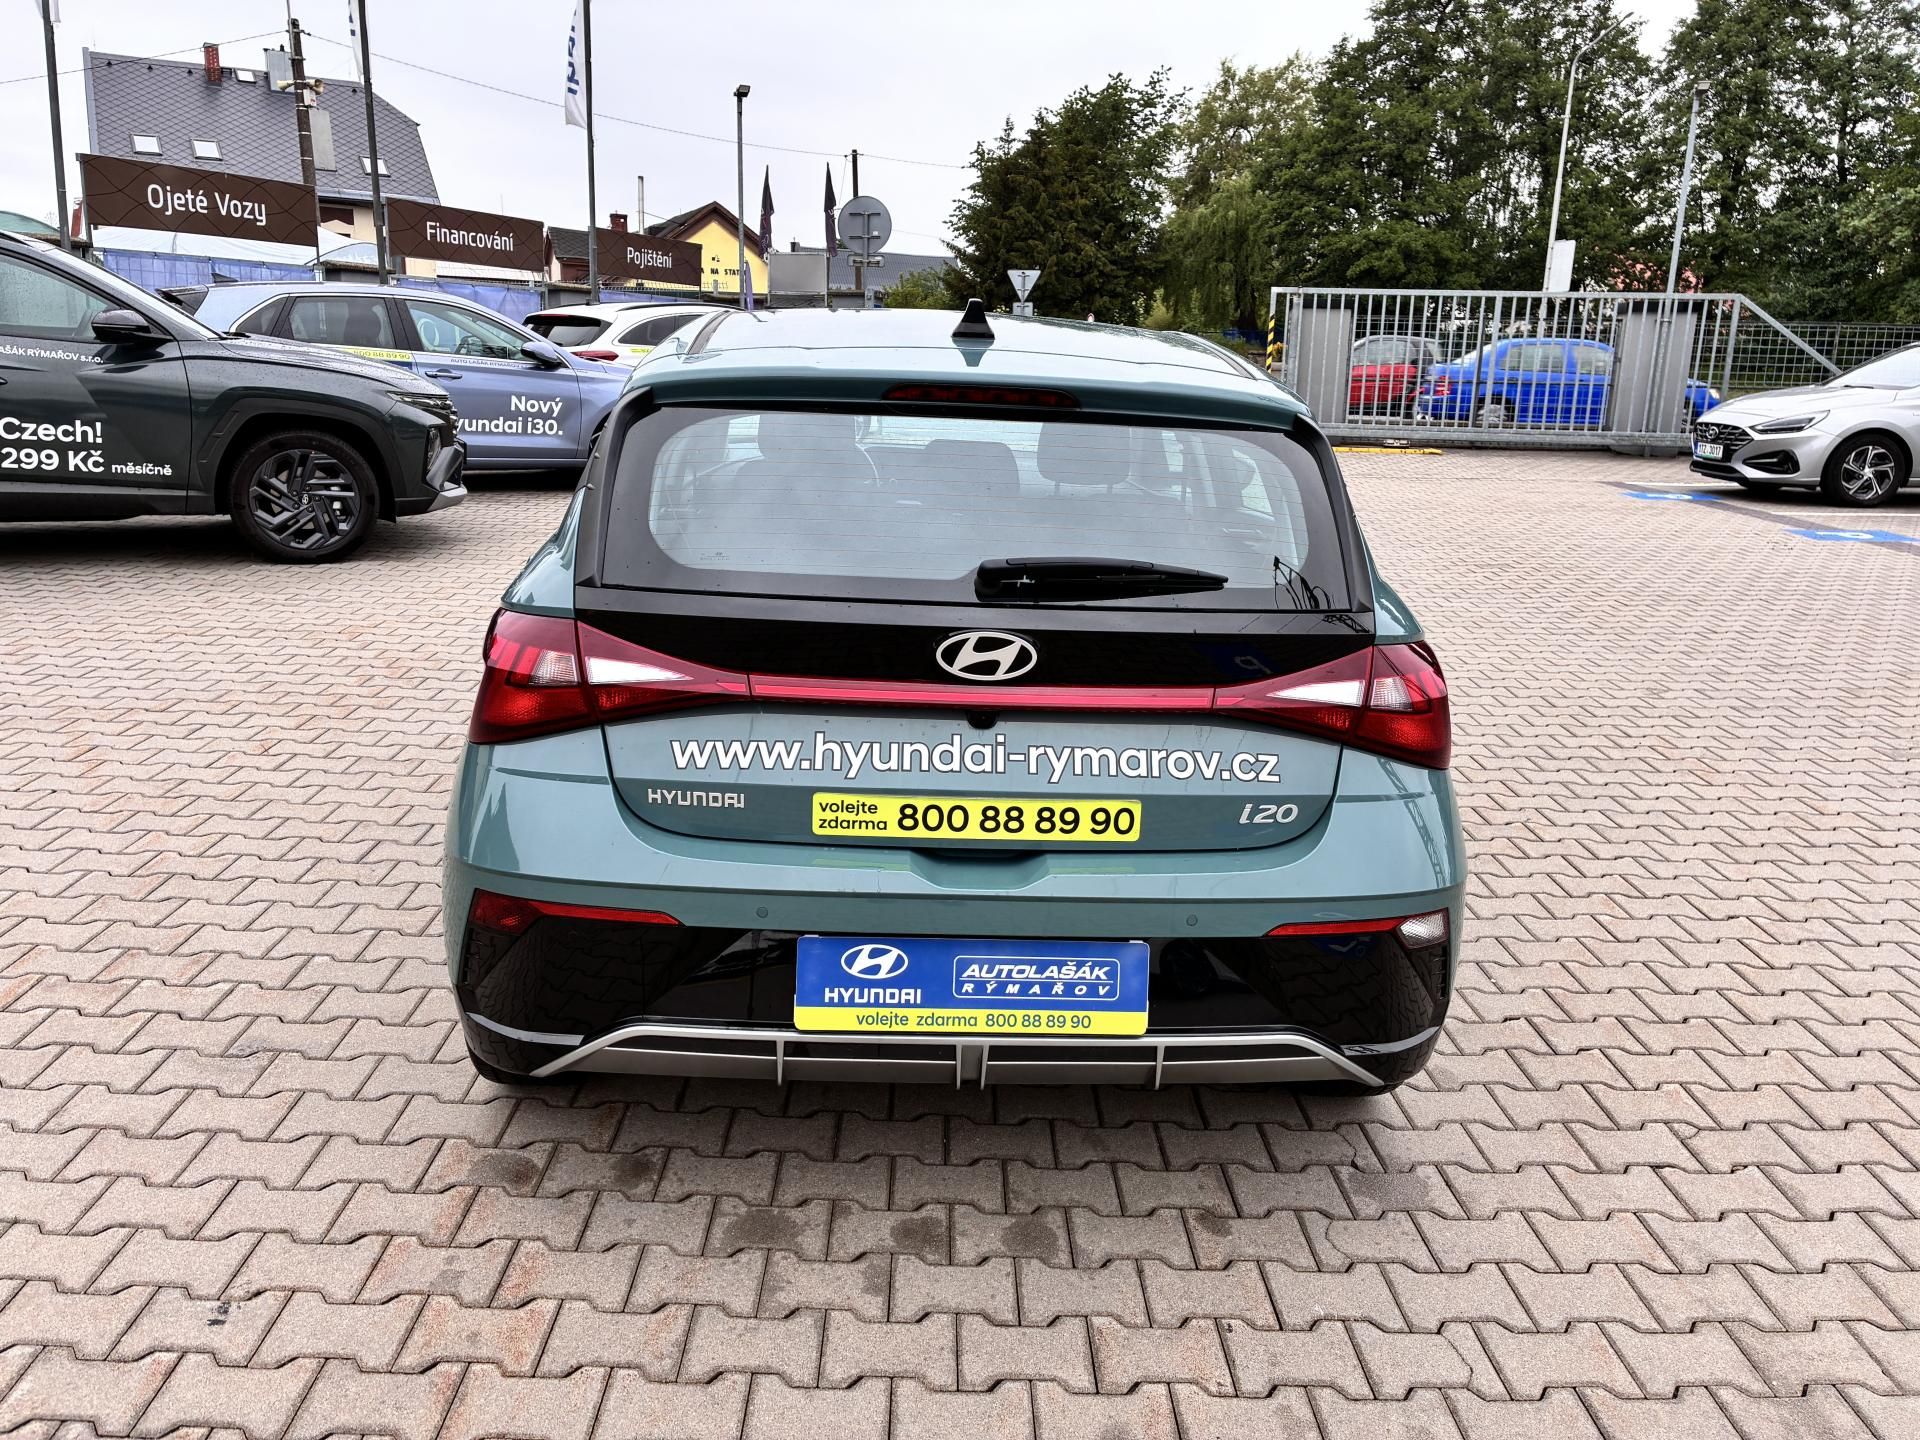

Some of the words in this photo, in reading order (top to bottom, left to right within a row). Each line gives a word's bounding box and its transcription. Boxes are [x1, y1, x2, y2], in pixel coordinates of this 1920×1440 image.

[147, 184, 208, 216] Ojeté
[214, 193, 266, 227] Vozy
[426, 221, 514, 252] Financování
[627, 246, 673, 269] Pojištění
[27, 347, 79, 361] RÝMAŘOV
[80, 355, 104, 364] s.r.o.
[510, 395, 562, 417] Nový
[0, 416, 103, 443] Czech!
[457, 416, 523, 434] yundai
[527, 417, 563, 435] i30.
[1, 447, 59, 471] 299
[68, 450, 105, 473] Kč
[111, 461, 173, 476] měsíčně
[670, 731, 1282, 784] www.hyundai-rymarov.cz
[647, 788, 745, 808] HYUNDAI
[819, 800, 878, 816] volejte
[818, 816, 888, 831] zdarma
[897, 803, 970, 833] 800
[979, 805, 1025, 834] 88
[1034, 806, 1080, 835] 89
[1090, 807, 1135, 835] 90
[1238, 803, 1299, 825] i20
[961, 961, 1112, 980] AUTOLAŠÁK
[824, 987, 921, 1005] HYUNDAI
[961, 981, 1111, 996] RÝMAŘOV
[856, 1012, 909, 1029] volejte
[916, 1012, 978, 1027] zdarma
[985, 1014, 1017, 1028] 800
[1021, 1014, 1042, 1028] 88
[1045, 1015, 1066, 1029] 89
[1070, 1015, 1091, 1029] 90
